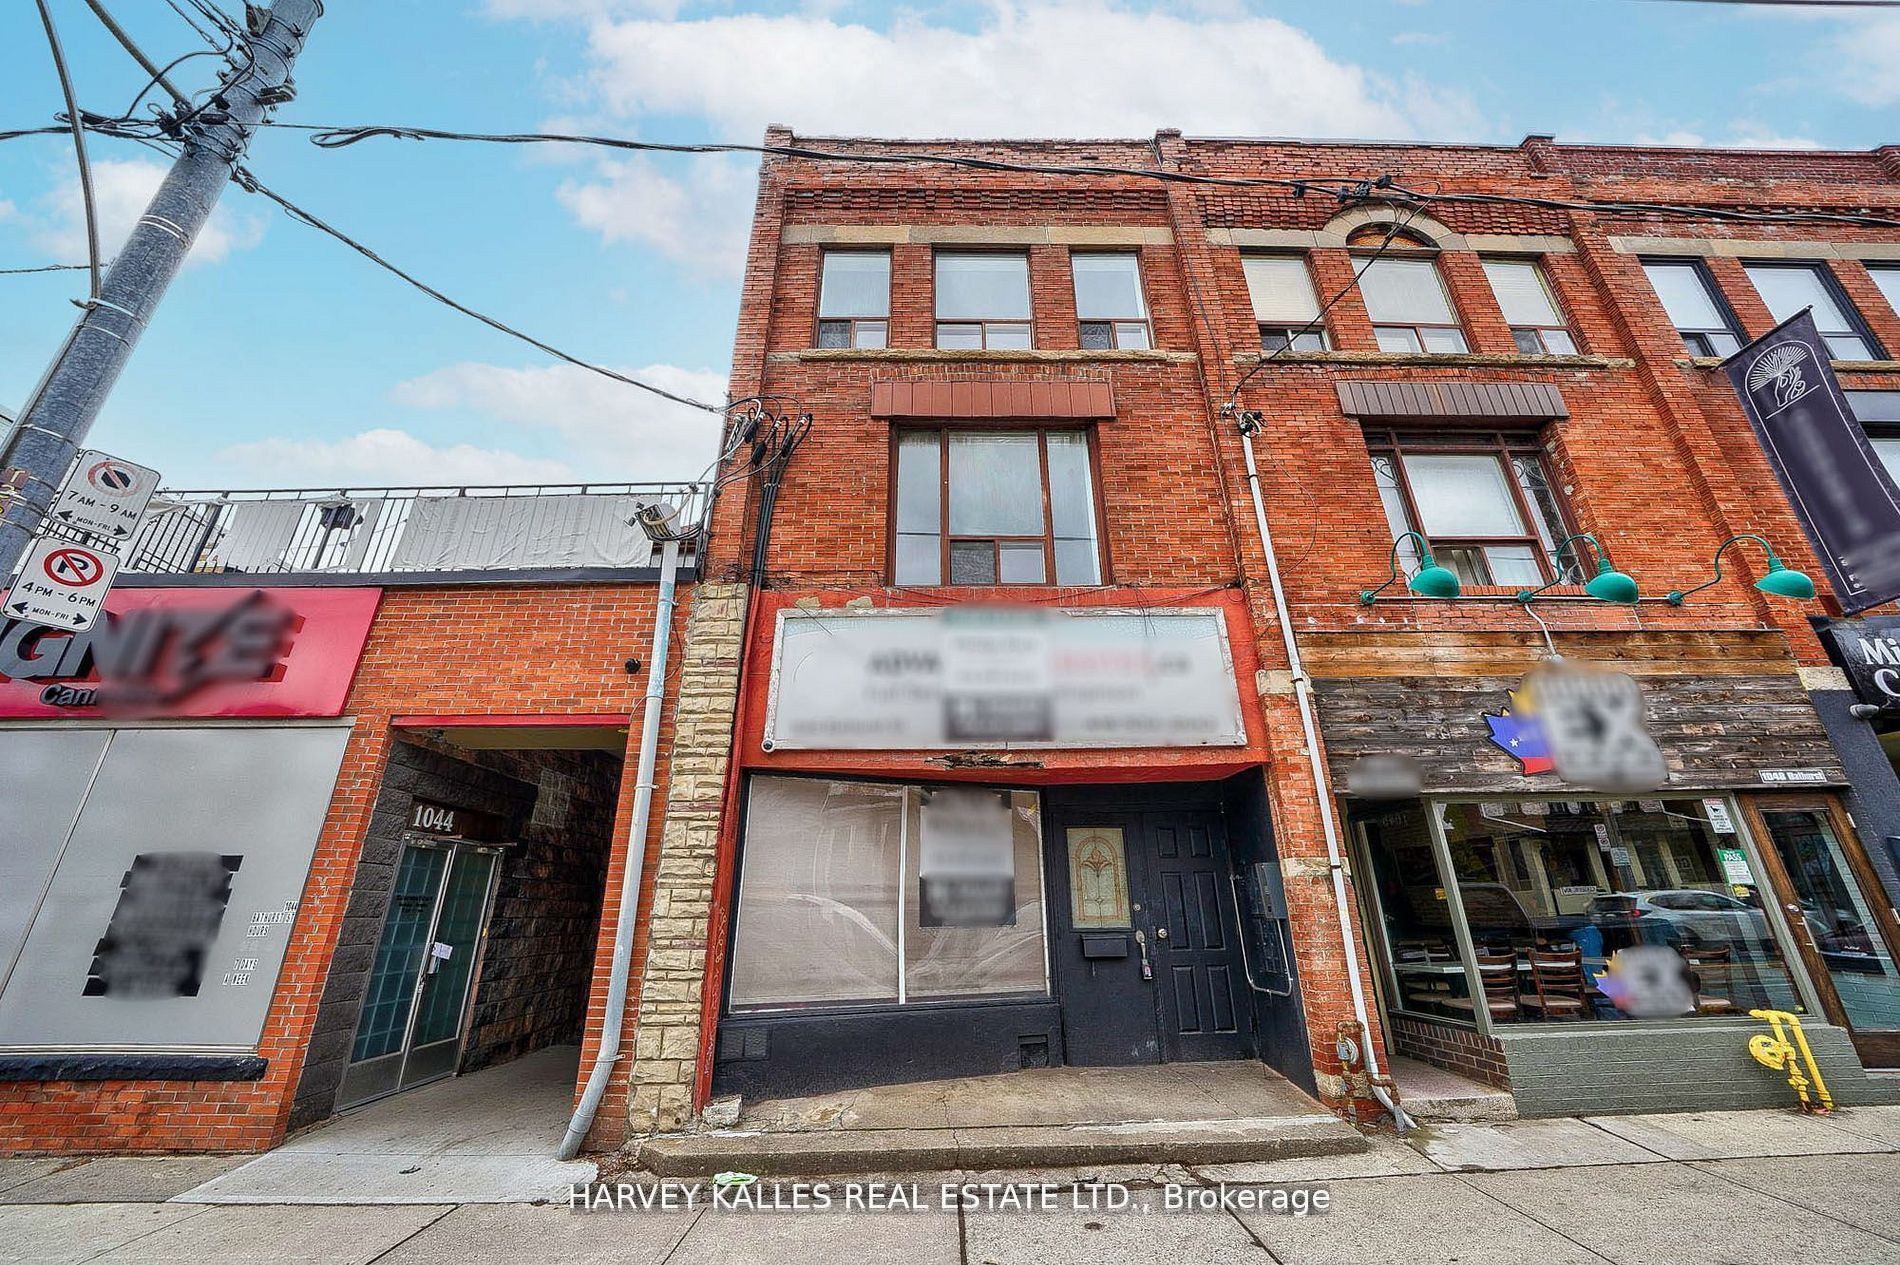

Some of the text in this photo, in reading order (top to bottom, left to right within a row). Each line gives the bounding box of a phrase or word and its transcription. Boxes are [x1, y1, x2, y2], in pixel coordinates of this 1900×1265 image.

[76, 517, 111, 530] MON-FRI
[32, 607, 69, 620] MON-FRI
[1761, 771, 1787, 781] 1048
[413, 804, 455, 832] 1044
[1723, 853, 1743, 861] PASS
[251, 911, 284, 924] BATHURST
[247, 925, 269, 937] HOURS
[239, 958, 258, 971] DAYS
